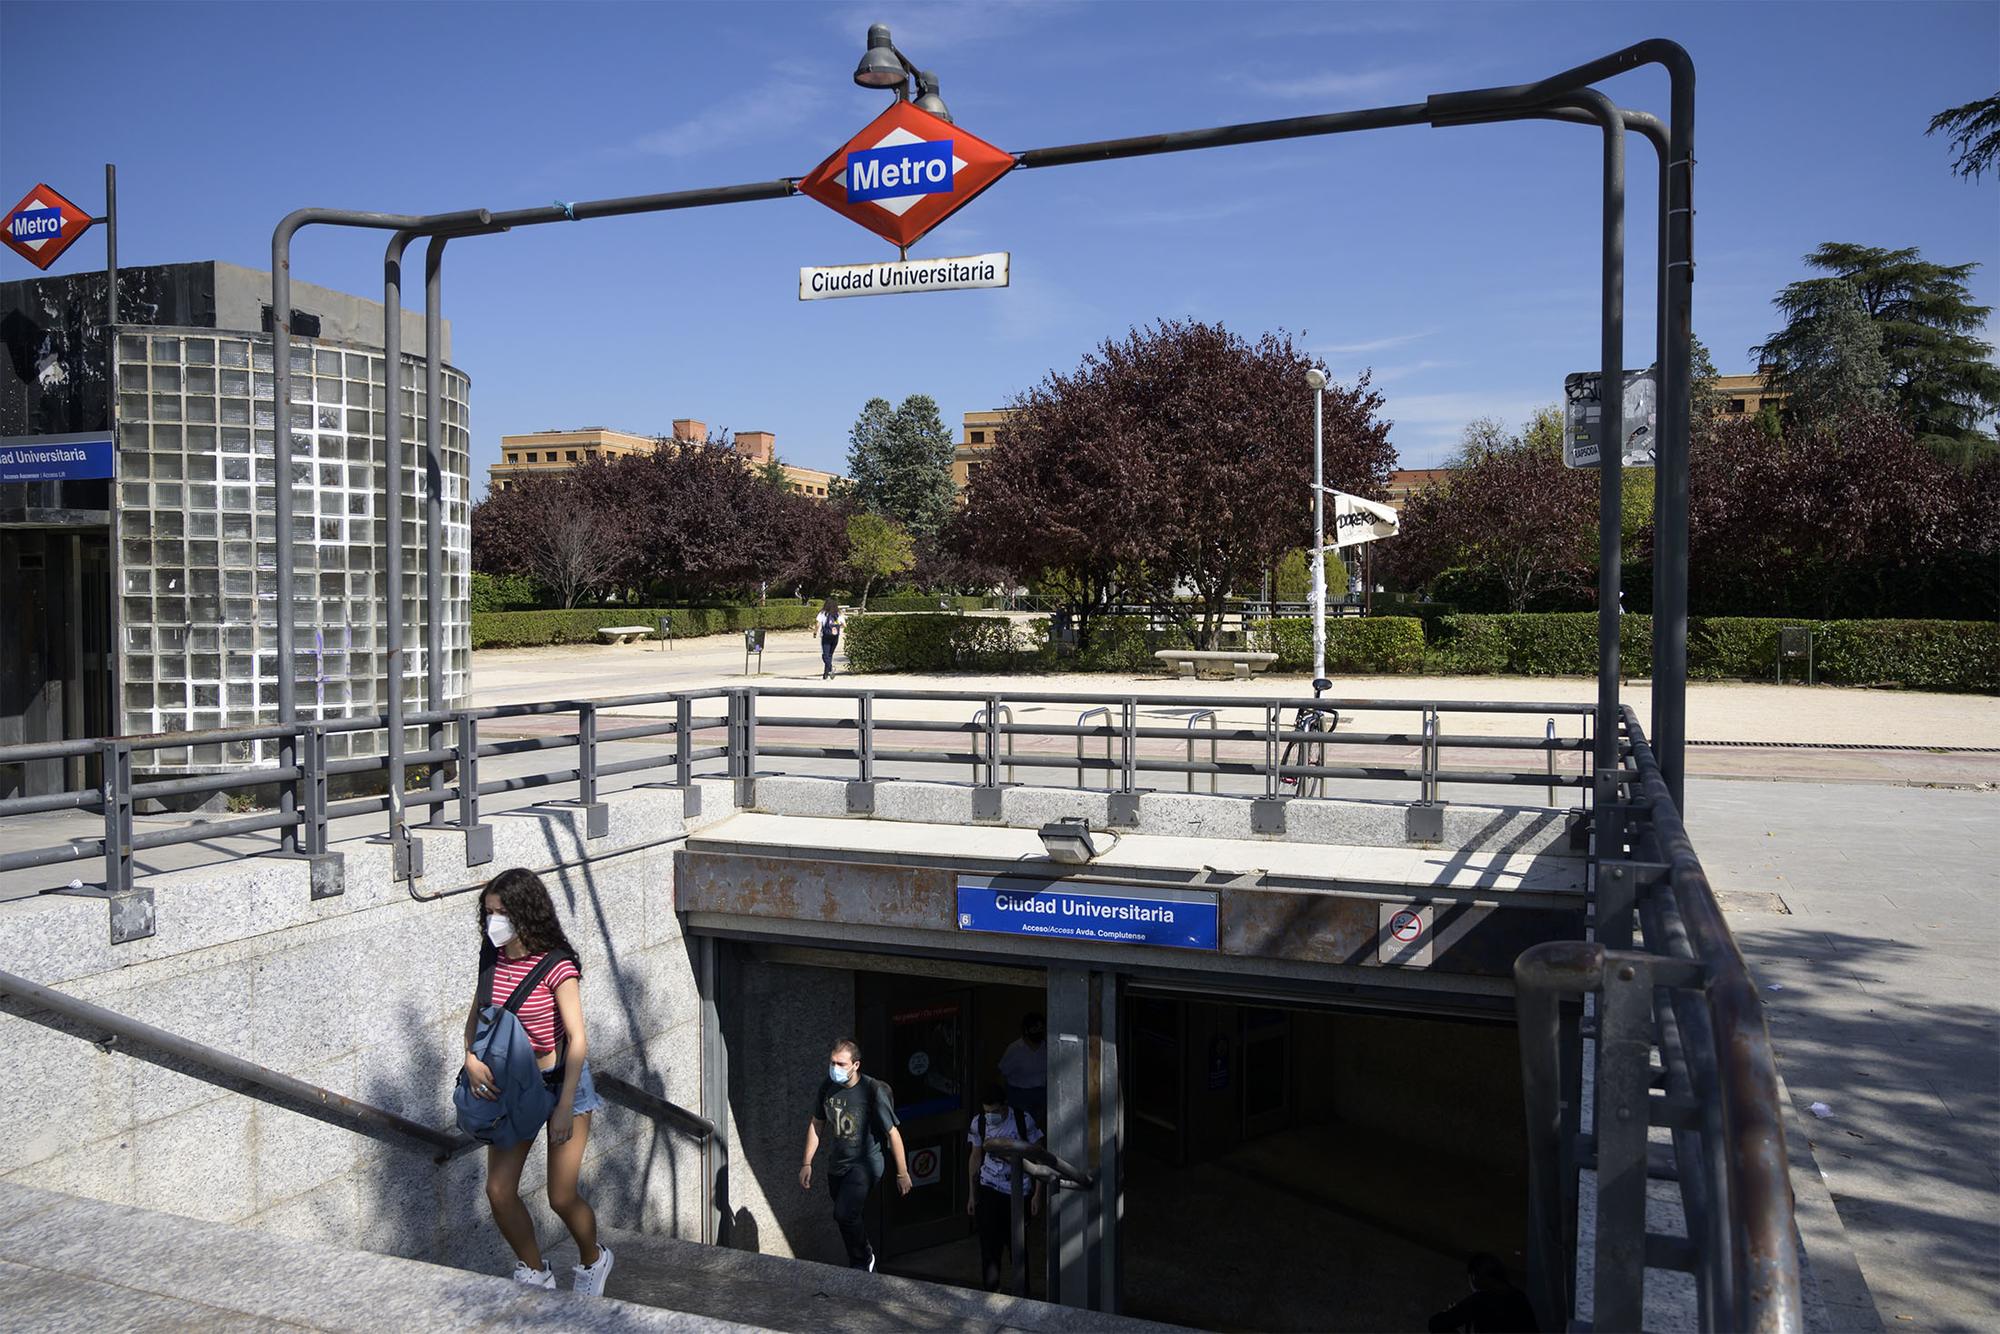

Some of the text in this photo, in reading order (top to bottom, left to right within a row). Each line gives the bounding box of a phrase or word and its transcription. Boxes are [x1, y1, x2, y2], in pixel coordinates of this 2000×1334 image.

[853, 157, 947, 192] Metro
[15, 217, 58, 236] Metro
[811, 261, 995, 292] Ciudad Universitaria
[15, 448, 87, 464] Universitaria
[995, 894, 1175, 923] Ciudad Universitaria
[962, 915, 969, 924] 6
[1022, 923, 1146, 941] Acceso/Access Avda. Complutense
